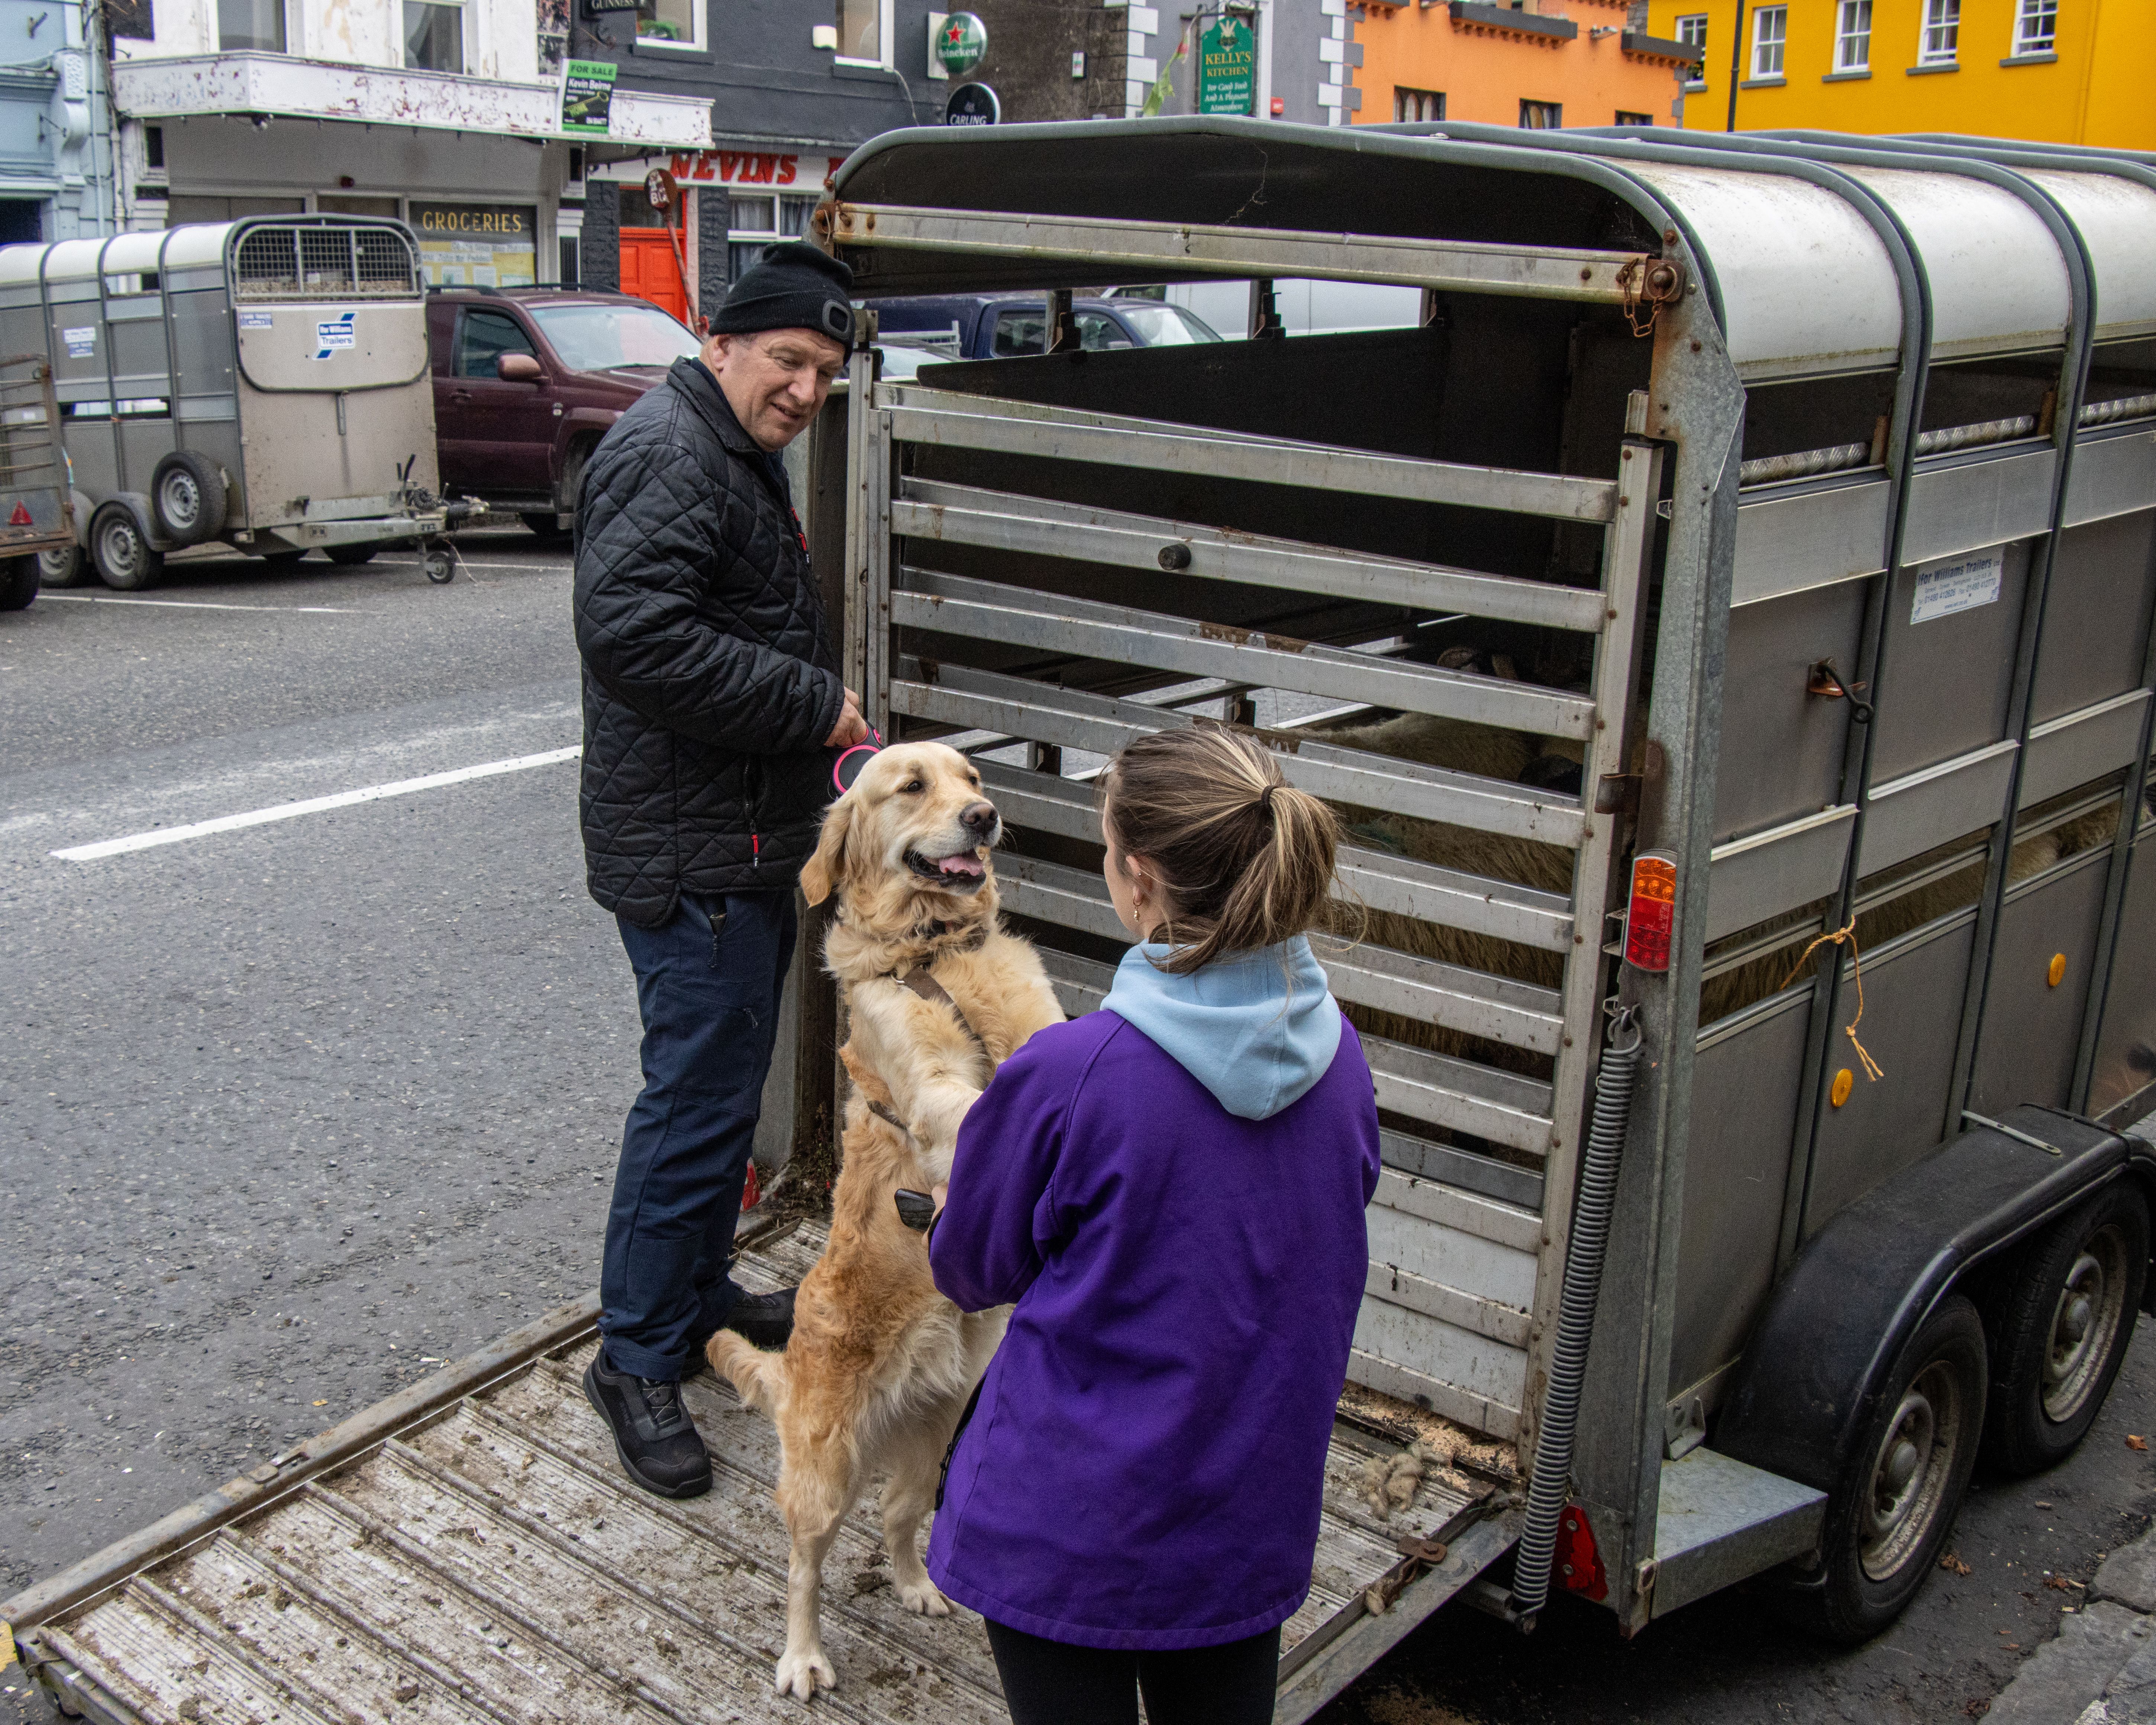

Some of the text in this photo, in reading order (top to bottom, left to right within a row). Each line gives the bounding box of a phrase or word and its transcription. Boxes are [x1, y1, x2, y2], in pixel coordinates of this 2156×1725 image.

[938, 47, 978, 58] Heineken
[1206, 51, 1251, 65] KELLY'S
[571, 64, 613, 75] FOR SALE
[1207, 67, 1248, 77] KITCHEN
[568, 77, 588, 89] Kevin
[950, 114, 987, 126] CARLING
[671, 151, 797, 184] NEVINS
[423, 210, 522, 233] GROCERIES
[322, 336, 352, 345] Trailers
[1917, 573, 1932, 586] Ifor
[1934, 565, 1964, 582] Williams
[1966, 558, 1992, 574] Trailers
